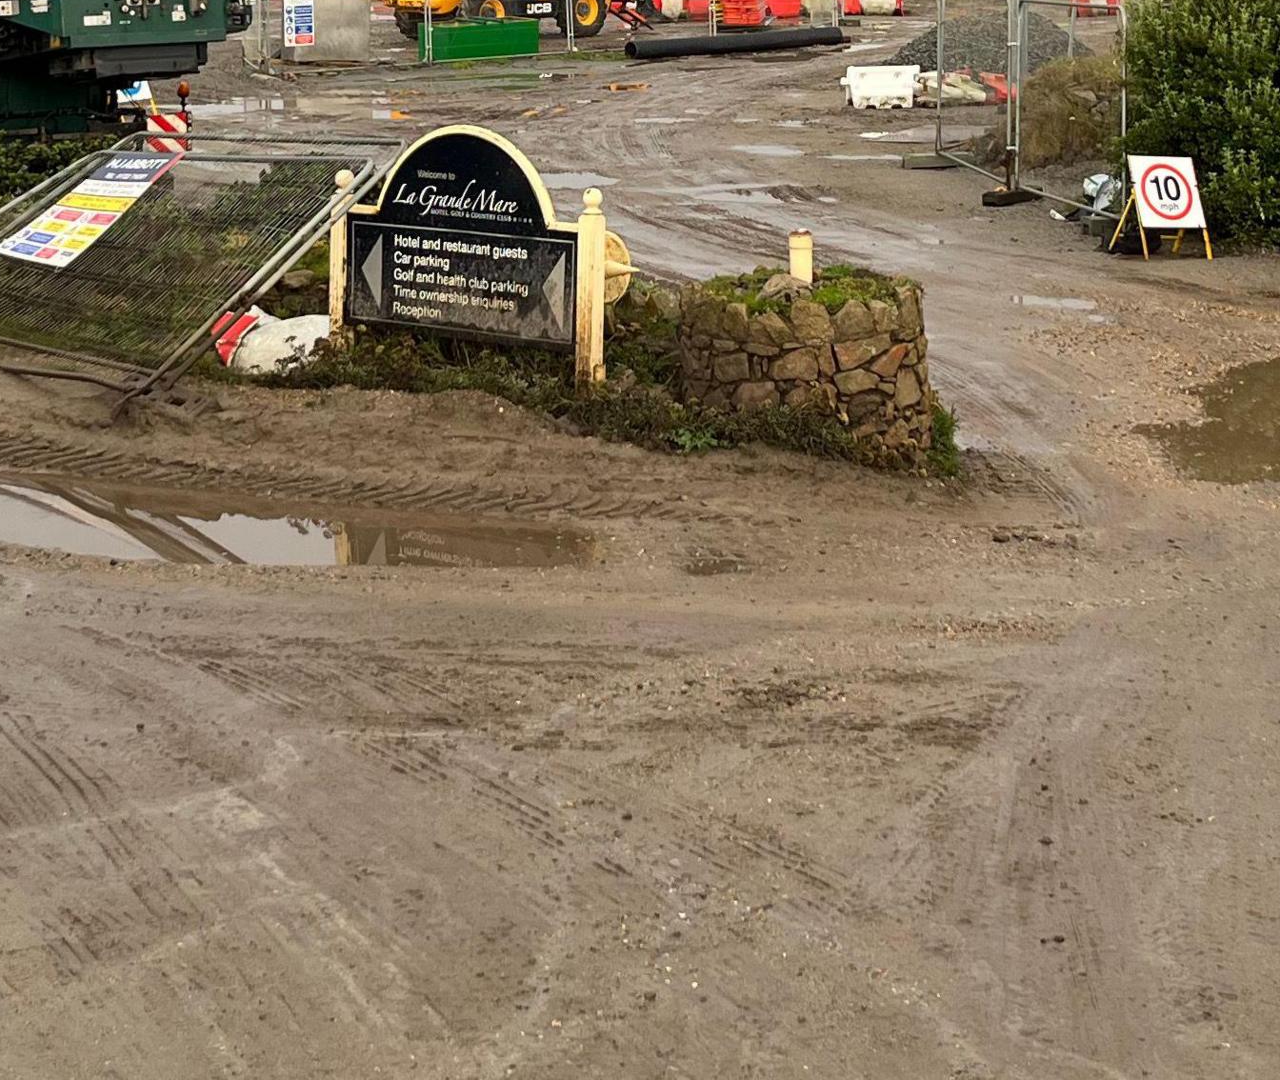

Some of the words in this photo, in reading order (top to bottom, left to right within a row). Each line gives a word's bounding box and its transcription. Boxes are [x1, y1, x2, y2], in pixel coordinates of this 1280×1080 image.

[527, 2, 552, 14] JCB
[121, 158, 170, 169] ABBOTT
[417, 169, 448, 180] Welcome
[449, 172, 456, 181] to
[392, 183, 418, 205] La
[419, 179, 476, 216] Grande
[471, 189, 518, 213] Mare
[1150, 176, 1181, 201] 10
[451, 210, 464, 218] GOLF
[470, 211, 496, 220] COUNTRY
[497, 213, 512, 222] CLUB
[1160, 203, 1180, 212] mph
[394, 233, 420, 248] Hotel
[422, 238, 441, 250] and
[442, 241, 491, 256] restaurant
[492, 245, 528, 260] guests
[394, 251, 411, 264] Car
[413, 254, 450, 271] parking
[393, 268, 414, 281] Golf
[416, 272, 435, 284] and
[436, 272, 467, 288] health
[468, 277, 489, 290] club
[490, 281, 529, 297] parking
[393, 284, 417, 299] Time
[419, 289, 469, 306] ownership
[471, 296, 515, 311] enquiries
[393, 301, 442, 319] Reception
